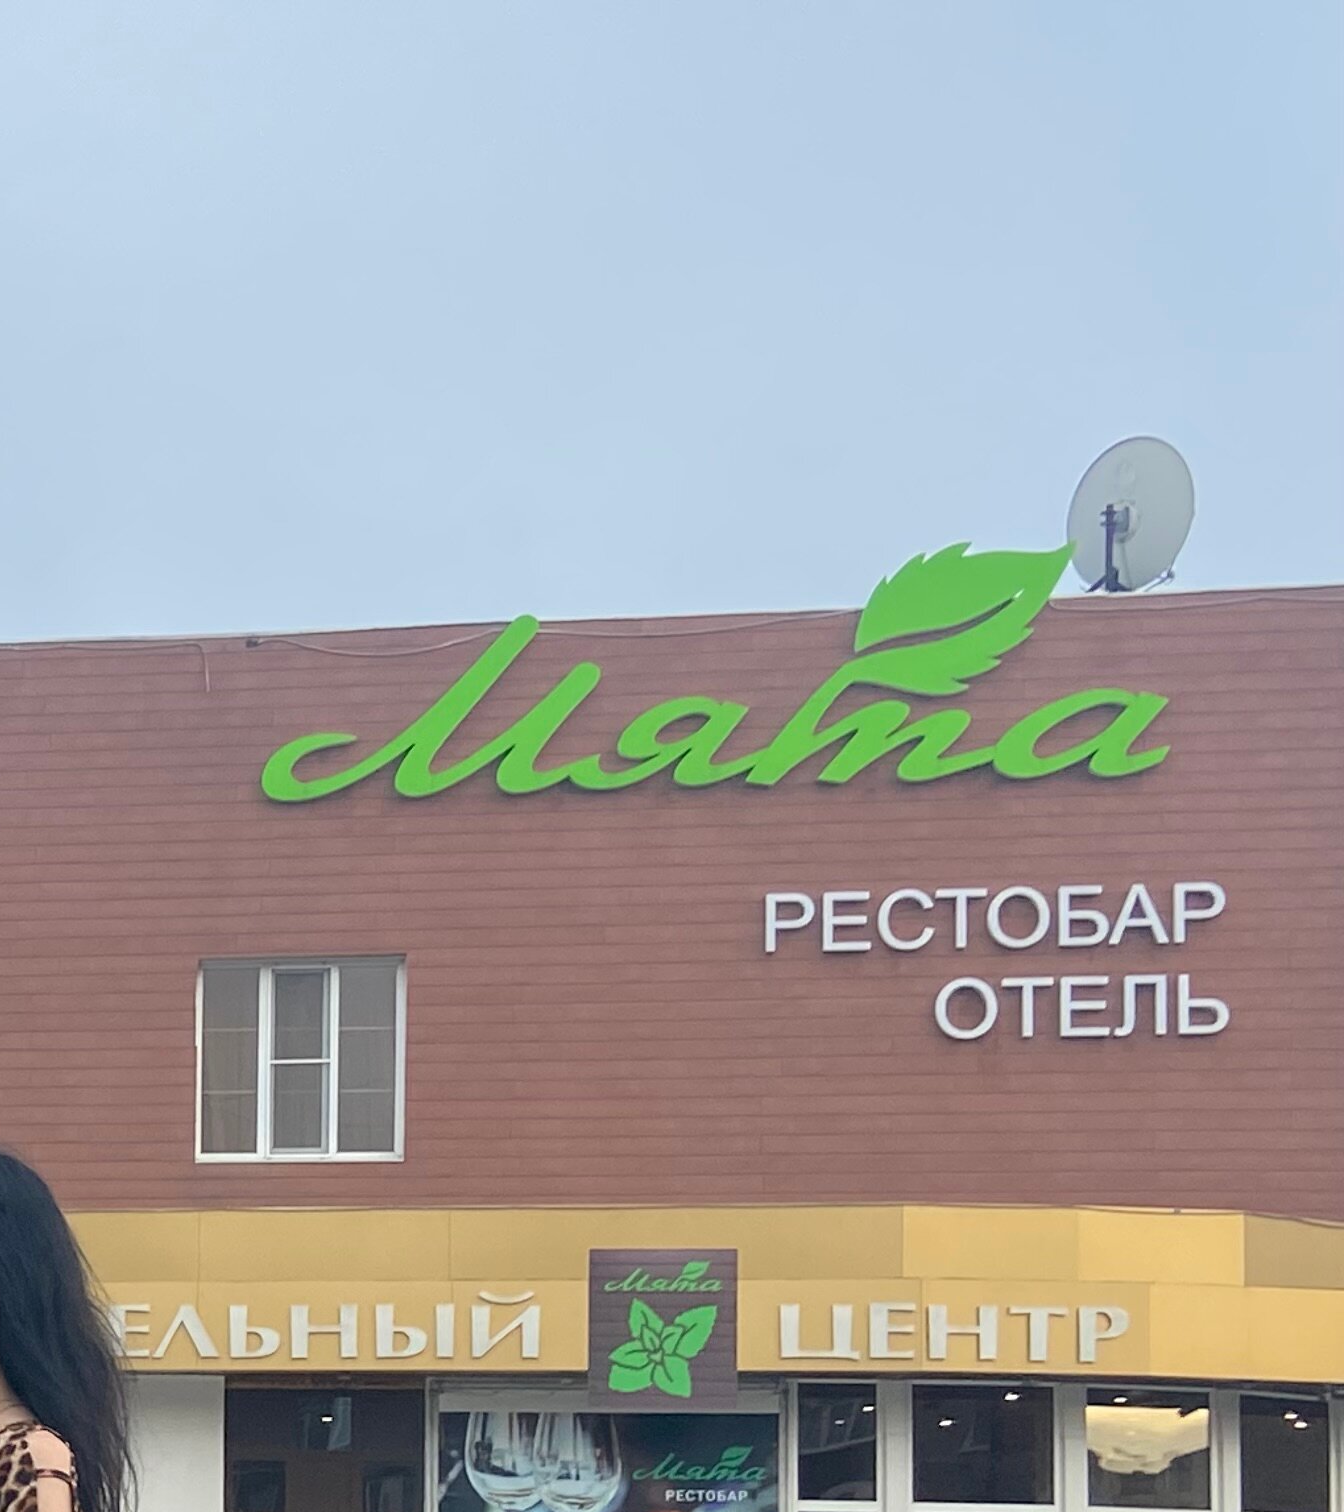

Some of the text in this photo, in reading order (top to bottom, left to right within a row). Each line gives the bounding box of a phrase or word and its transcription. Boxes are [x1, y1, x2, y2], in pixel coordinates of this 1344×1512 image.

[260, 541, 1170, 802] Мята
[762, 880, 1229, 954] РЕСТОБАР
[933, 972, 1232, 1041] ОТЕЛЬ
[604, 1260, 724, 1293] Мята
[778, 1301, 1132, 1366] ЦЕНТР
[632, 1446, 768, 1482] Мята
[664, 1488, 749, 1503] РЕСТОБАР
